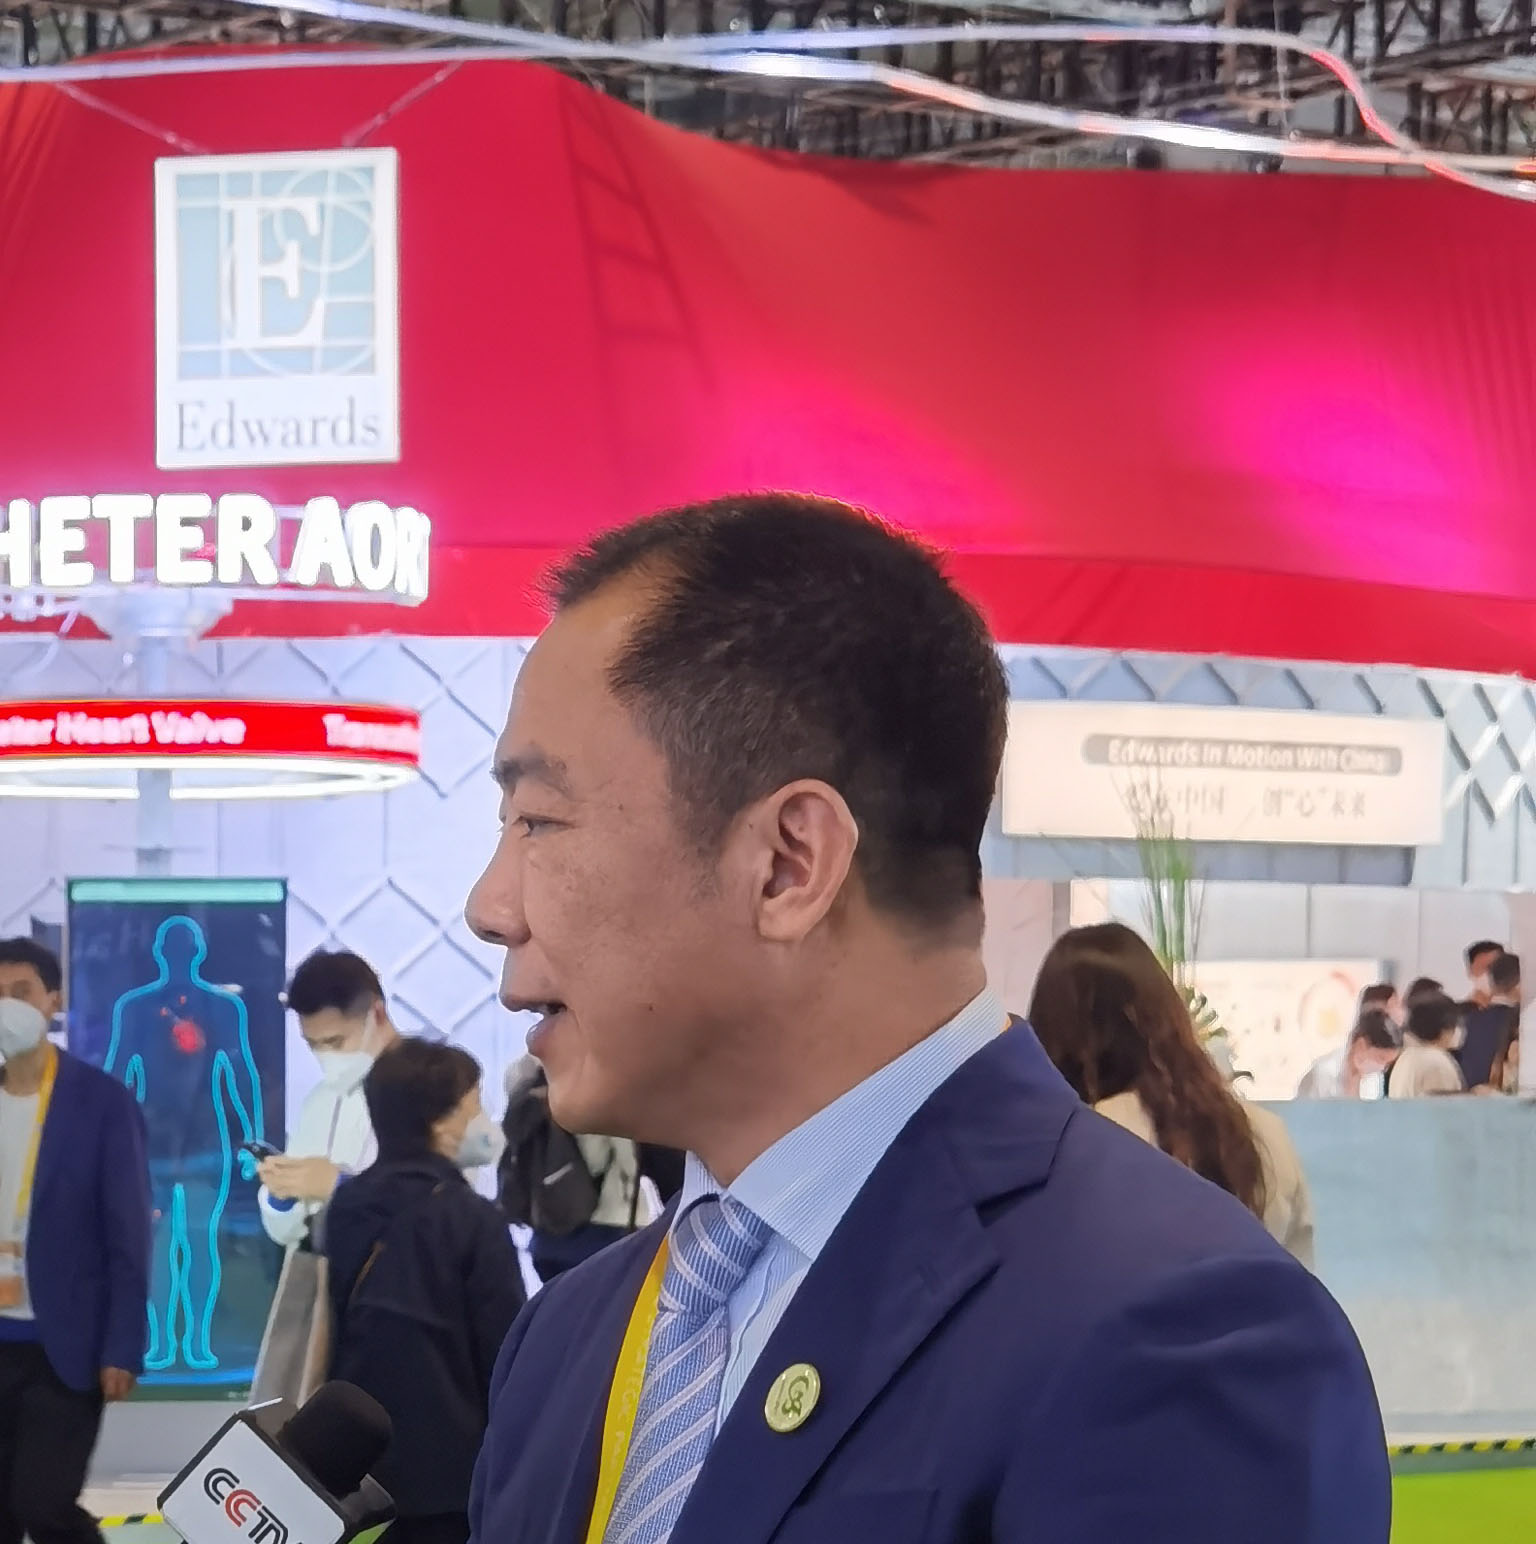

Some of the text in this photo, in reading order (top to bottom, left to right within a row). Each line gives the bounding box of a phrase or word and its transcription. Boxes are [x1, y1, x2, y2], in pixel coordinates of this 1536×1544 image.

[176, 396, 383, 453] Edwards
[1107, 738, 1199, 765] Edwards
[1227, 742, 1293, 768] Motion
[1296, 745, 1339, 770] With
